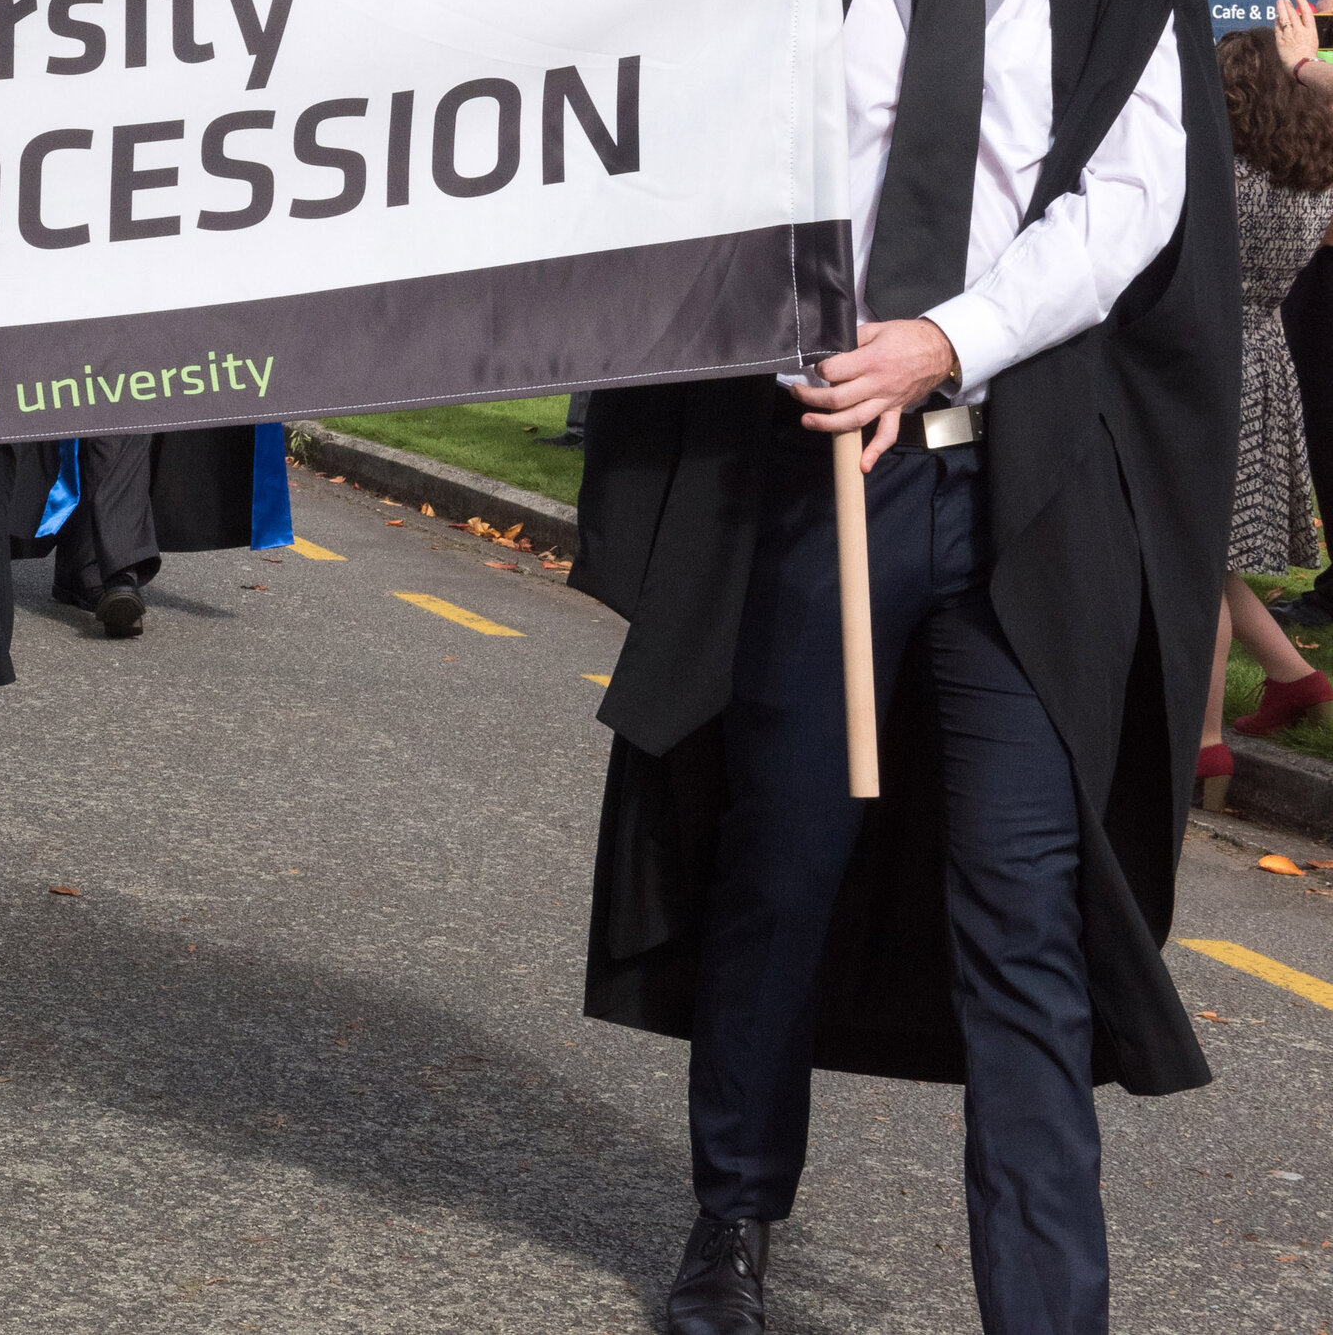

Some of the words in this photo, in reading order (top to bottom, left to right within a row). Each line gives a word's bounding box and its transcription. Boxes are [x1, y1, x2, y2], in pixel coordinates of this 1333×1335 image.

[1212, 4, 1245, 19] Cafe
[1249, 5, 1263, 20] &
[16, 351, 274, 412] university
